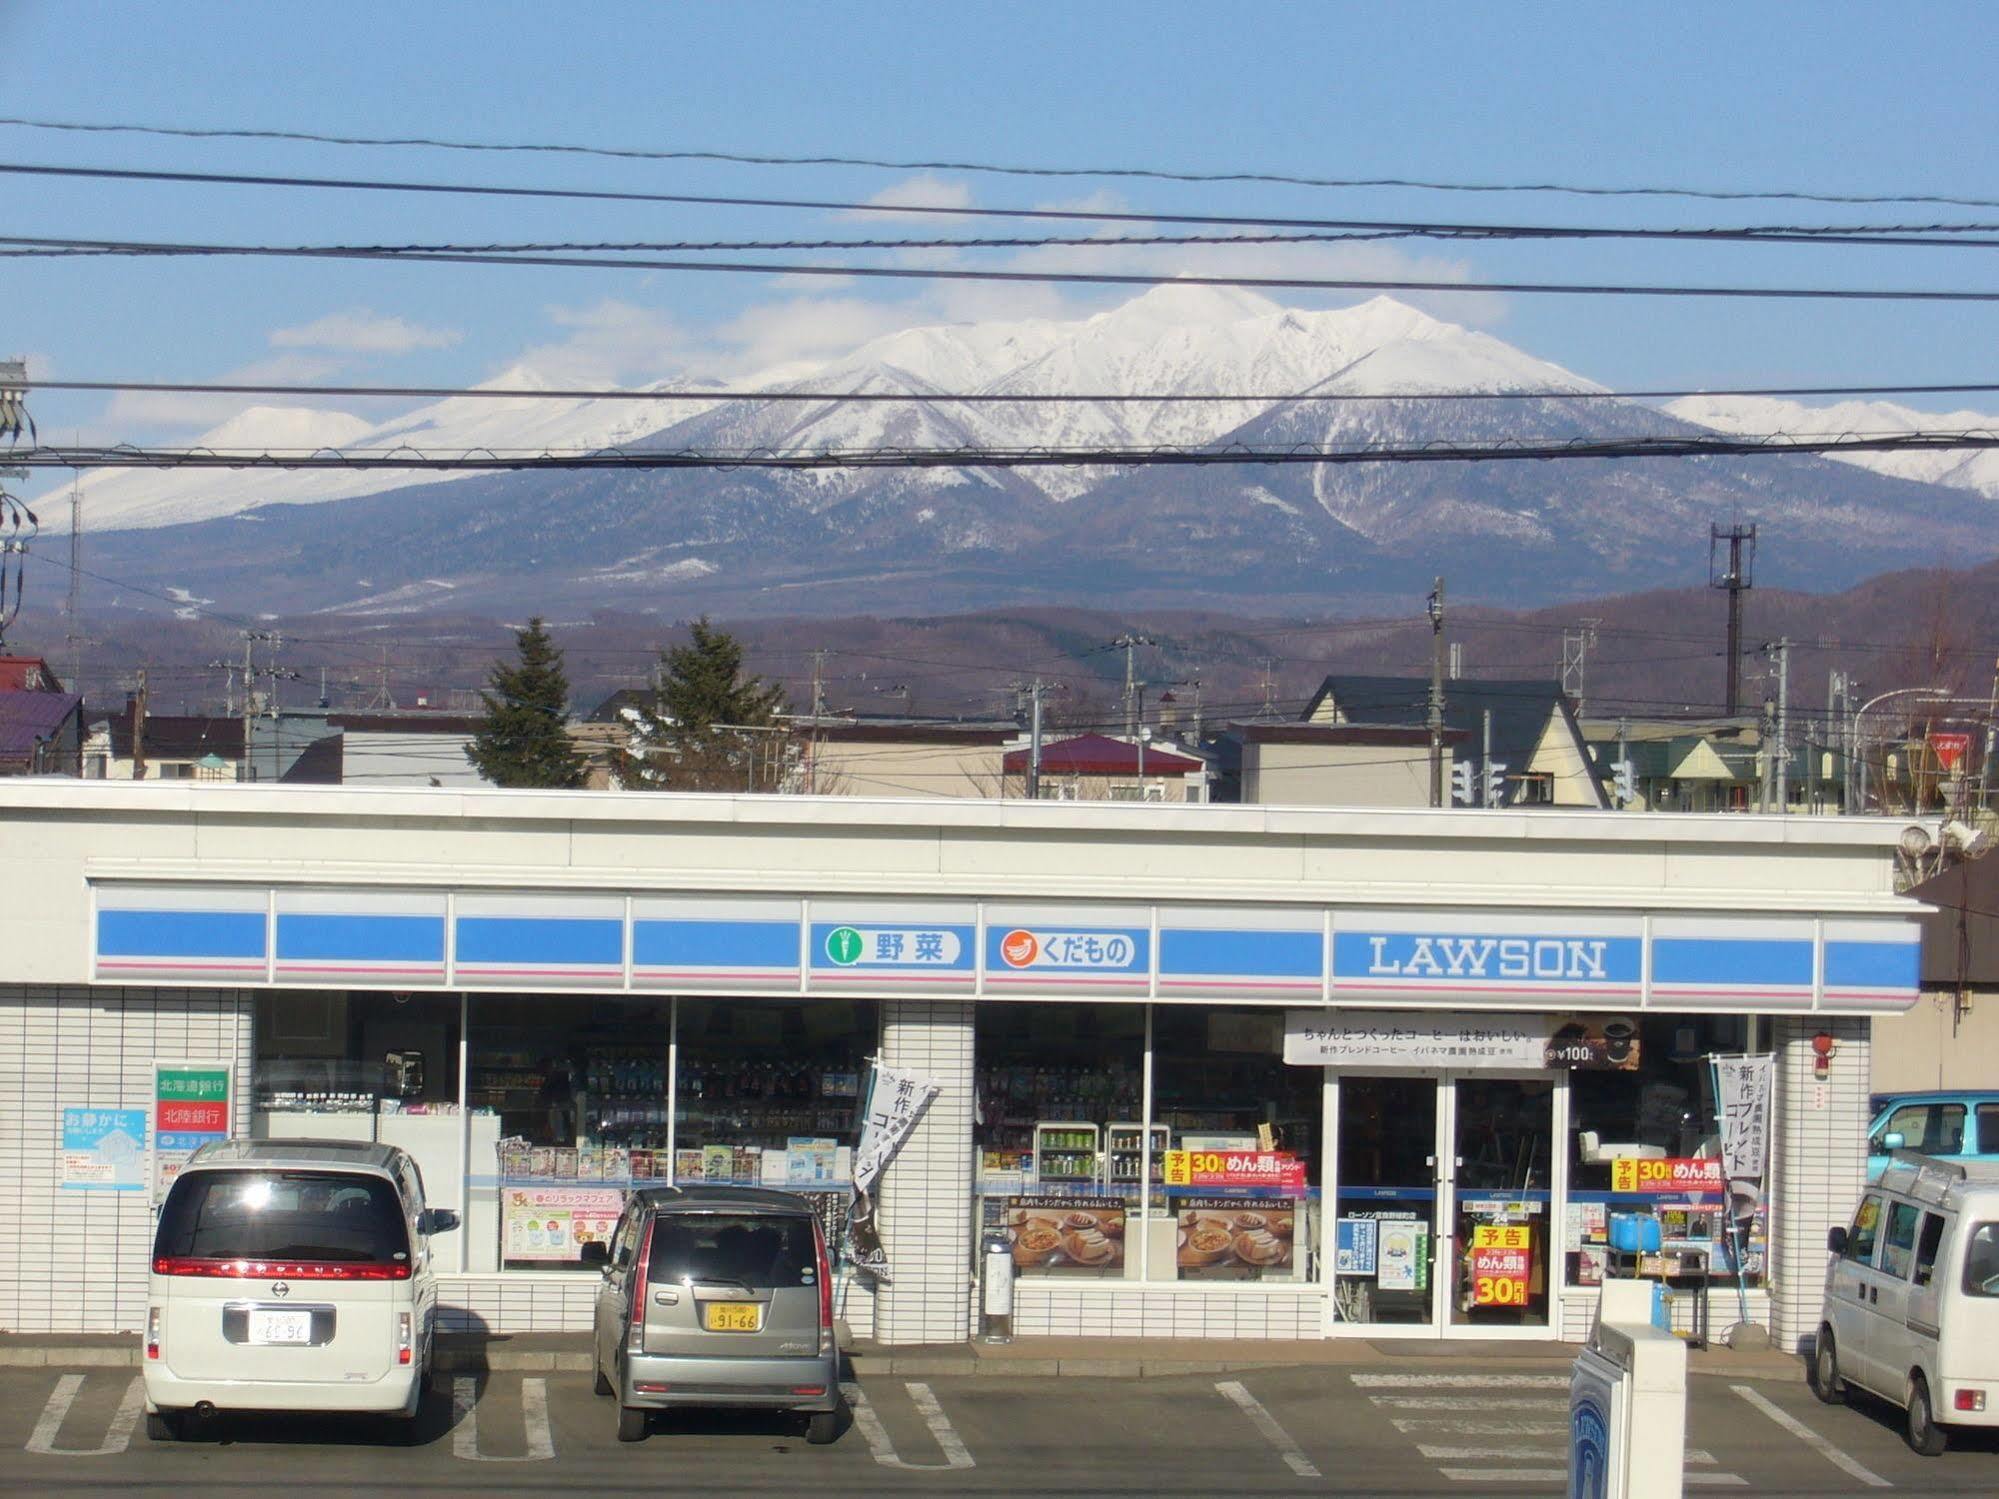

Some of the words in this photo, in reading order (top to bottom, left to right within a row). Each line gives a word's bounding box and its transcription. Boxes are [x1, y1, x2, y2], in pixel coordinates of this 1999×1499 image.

[876, 933, 943, 961] 野菜
[1043, 936, 1127, 964] くだもの
[1369, 936, 1607, 978] LAWSON
[160, 1079, 225, 1094] 北海道銀行
[165, 1109, 220, 1125] 北陸銀行
[1482, 1228, 1521, 1246] 予告
